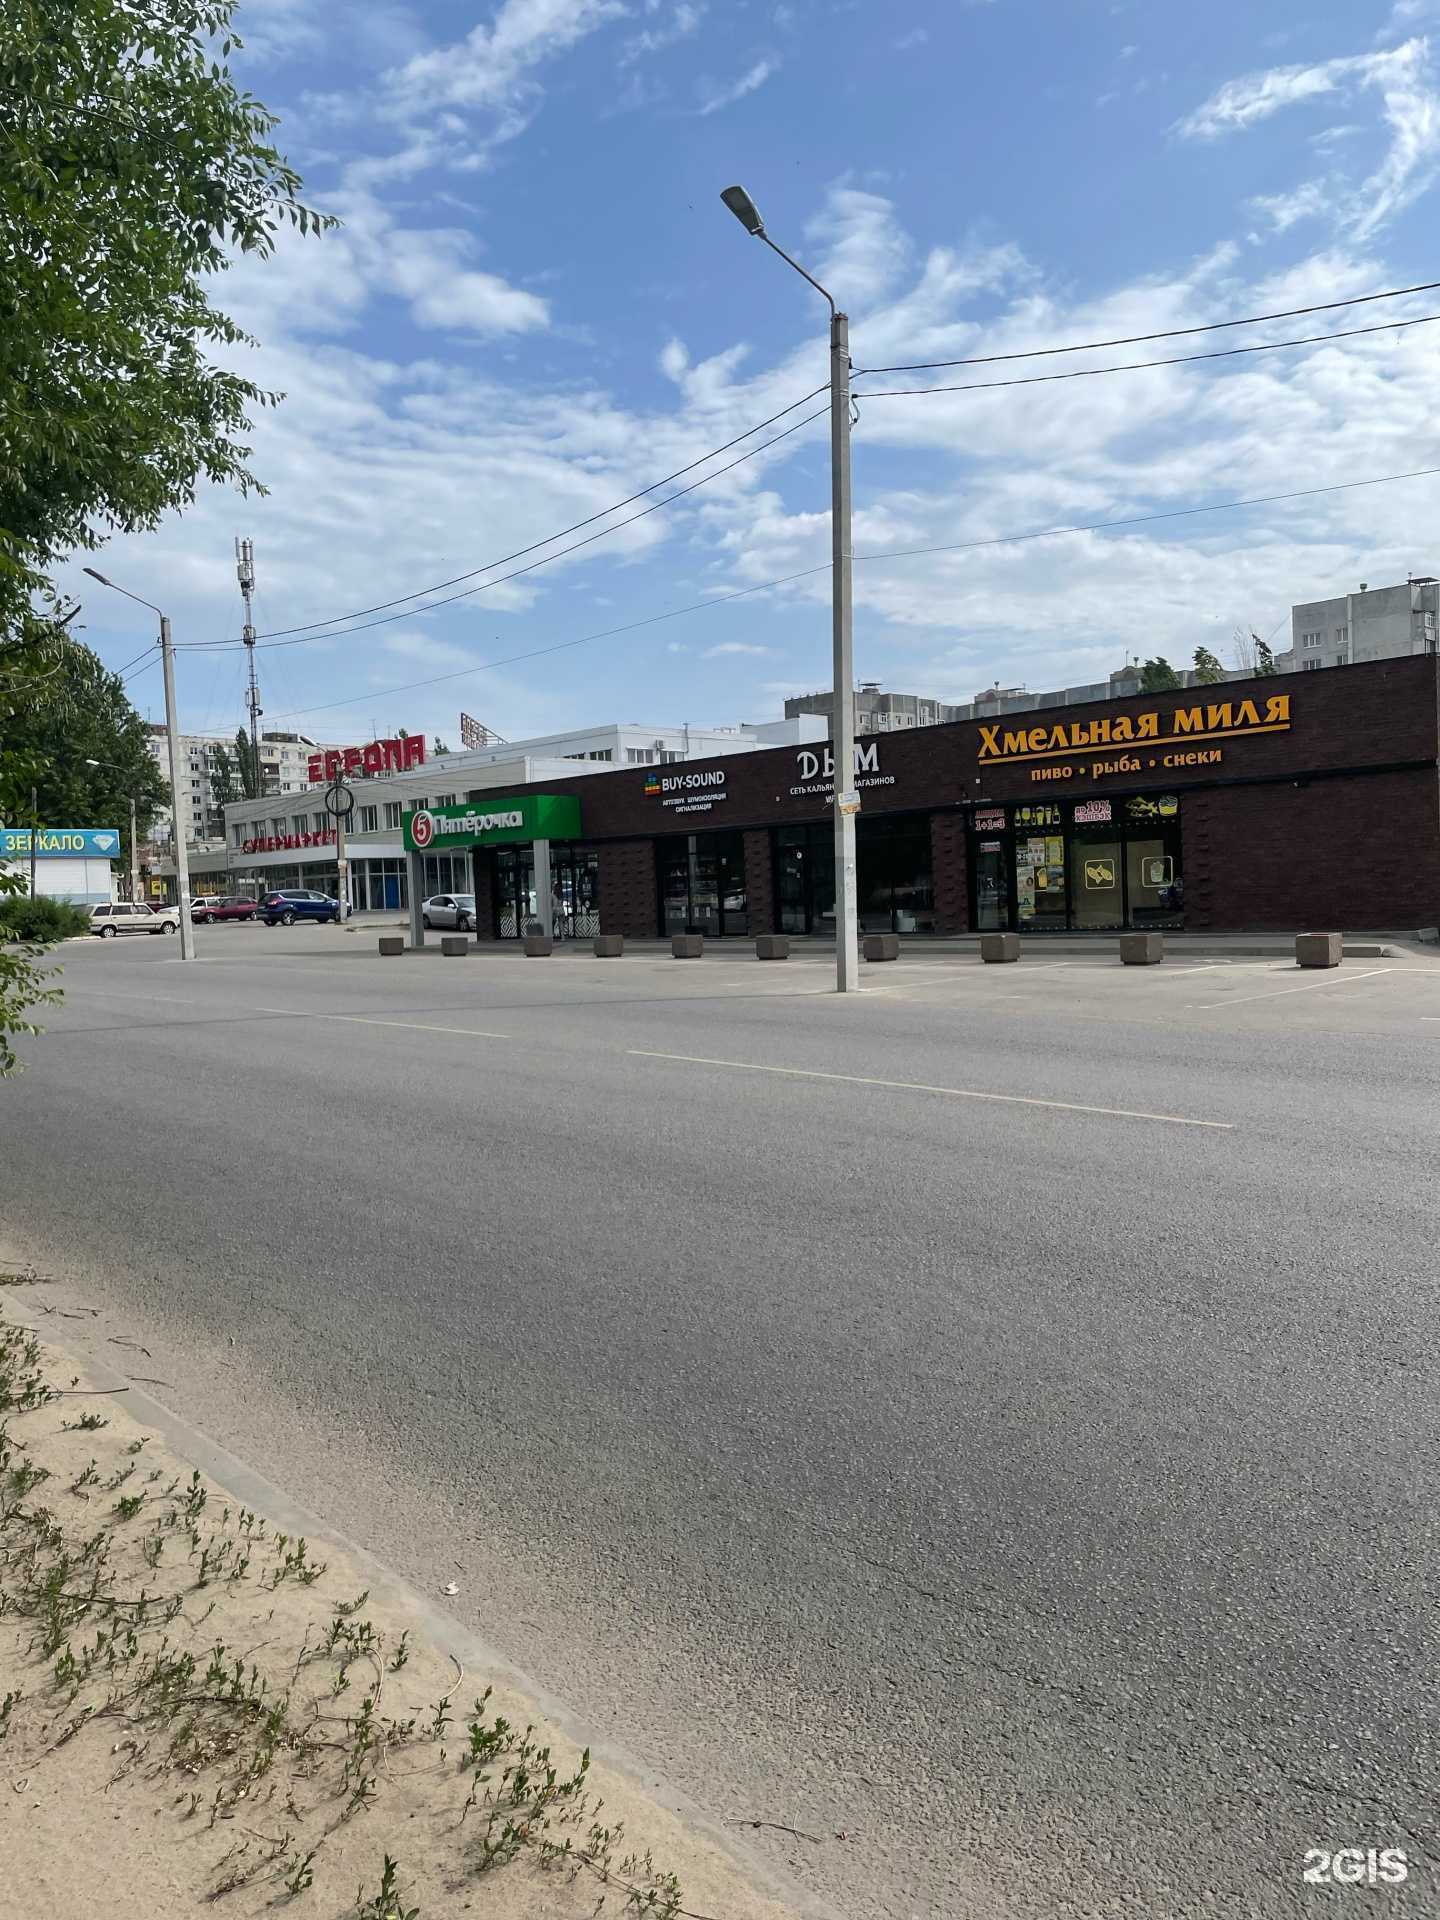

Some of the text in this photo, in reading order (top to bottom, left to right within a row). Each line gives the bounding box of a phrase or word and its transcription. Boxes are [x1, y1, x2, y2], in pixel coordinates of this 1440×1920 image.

[977, 694, 1290, 758] Хмельная миля
[1031, 749, 1222, 781] пиво рыба снеки
[662, 771, 725, 791] BUY-SOUND
[790, 776, 895, 795] СЕТЬ КАЛЬЯН АГАЗИНОВ
[432, 810, 523, 837] Пятёрочка
[5, 834, 85, 851] ЗЕРКАЛО
